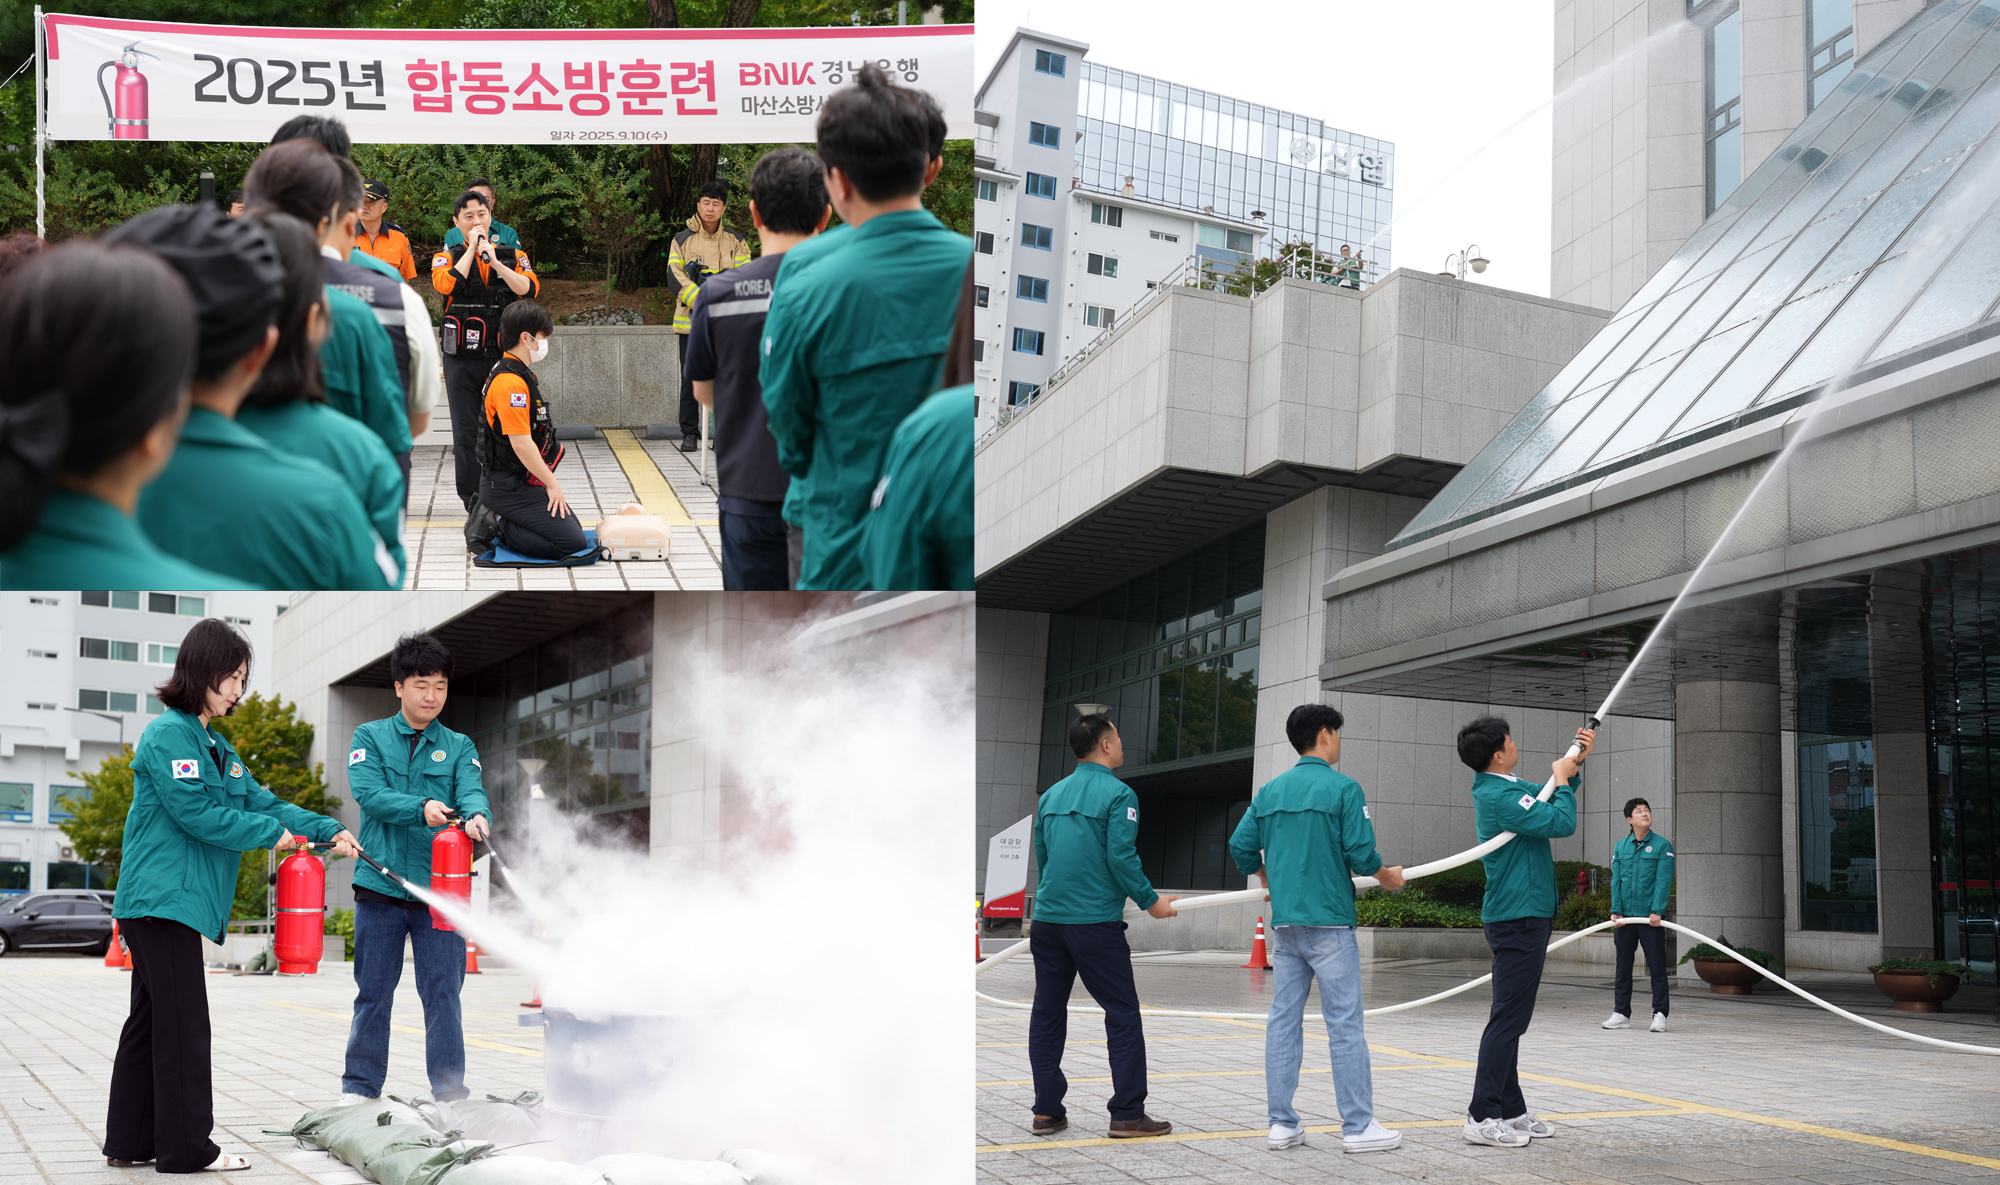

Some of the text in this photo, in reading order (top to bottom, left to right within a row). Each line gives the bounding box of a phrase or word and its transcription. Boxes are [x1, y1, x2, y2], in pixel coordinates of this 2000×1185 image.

[194, 53, 718, 116] 2025년 합동소방훈련
[739, 62, 817, 86] BNK
[550, 131, 668, 141] 일자 2025.9.10(수)
[735, 279, 773, 297] KOREA
